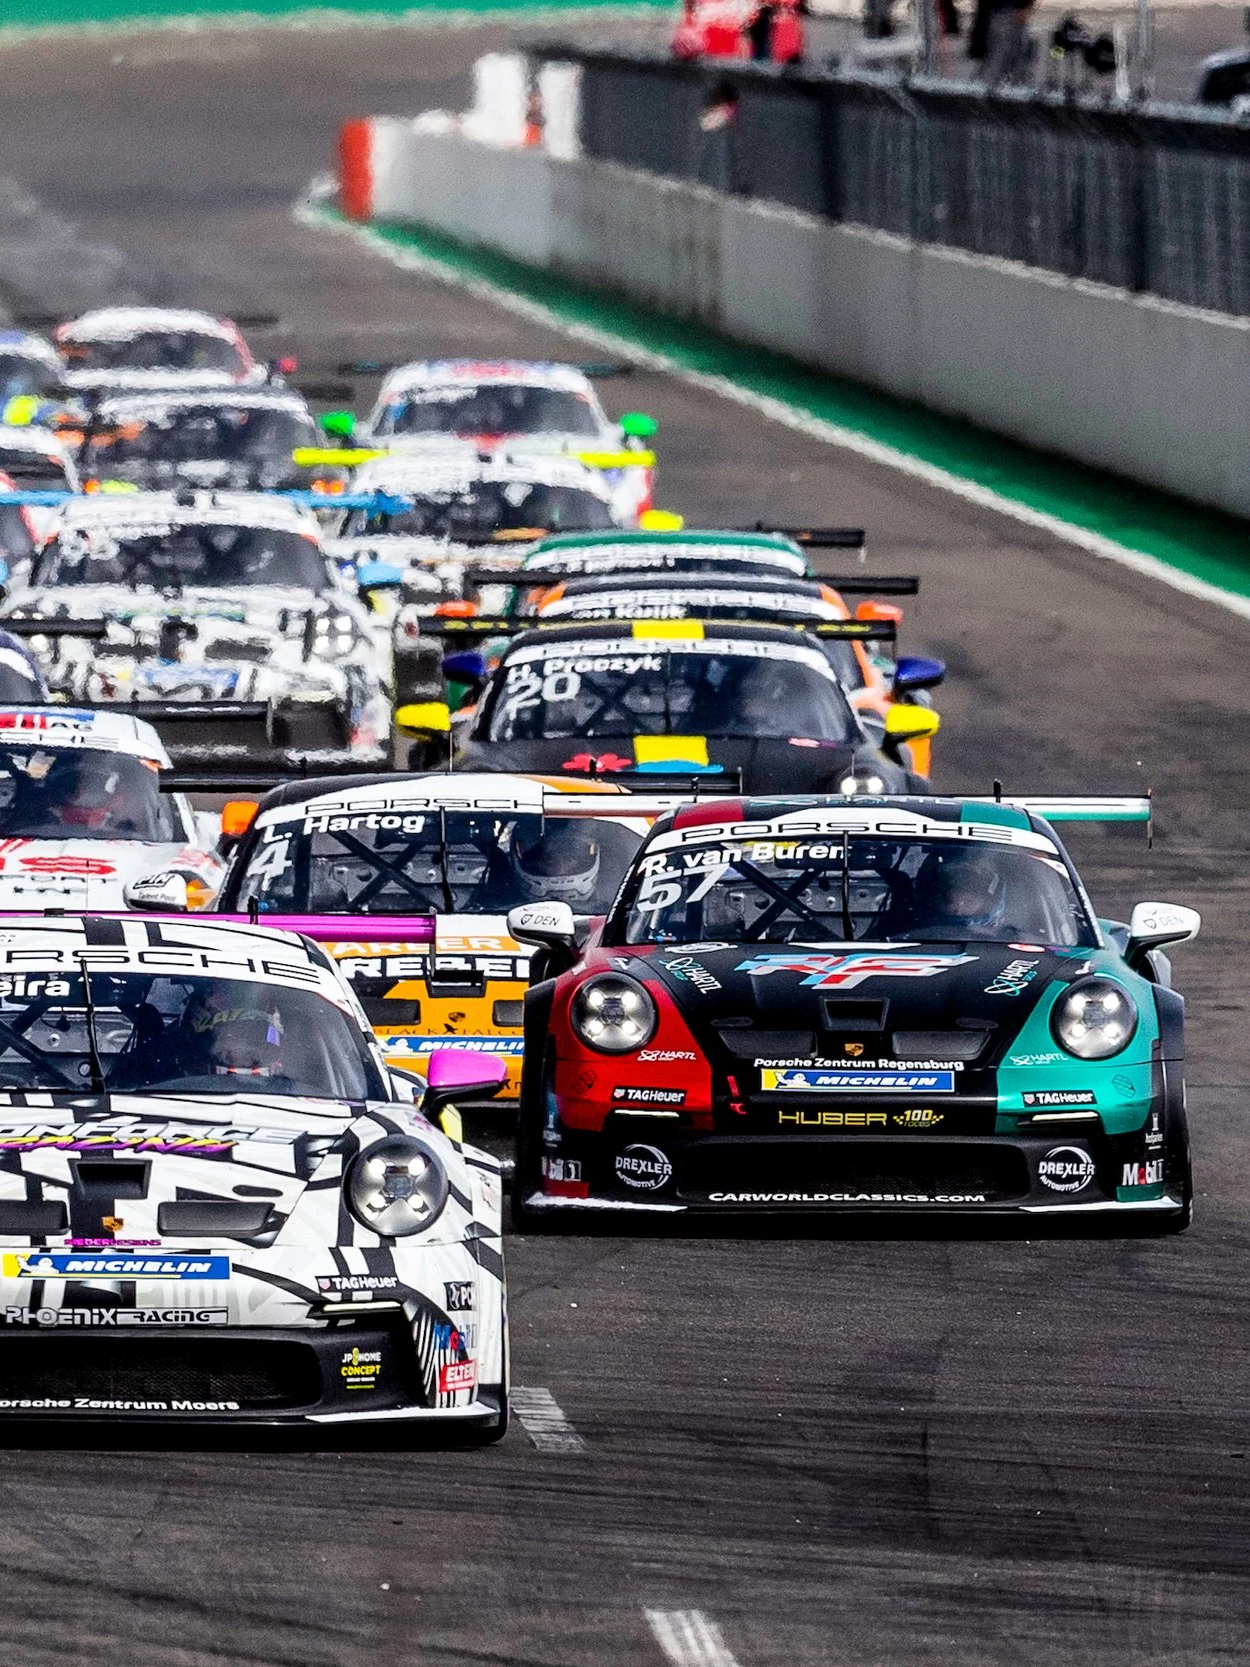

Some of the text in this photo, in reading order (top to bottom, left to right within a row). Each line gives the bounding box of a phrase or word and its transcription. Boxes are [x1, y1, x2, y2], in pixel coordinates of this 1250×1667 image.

[305, 798, 544, 816] PORSCH
[262, 813, 426, 844] L. Hartog
[681, 822, 1014, 843] PORSCHE
[246, 838, 293, 891] 4
[646, 840, 853, 878] R. van Buren
[635, 862, 731, 914] 57
[462, 1026, 525, 1036] FALCO
[754, 1057, 964, 1071] Porsche Zentrum Regensburg
[816, 1076, 937, 1086] MICHELIN
[627, 1089, 684, 1103] TAGHeuer
[1036, 1092, 1094, 1104] TAGHeuer
[778, 1109, 934, 1126] HUBER 100
[615, 1155, 673, 1175] DREXLER
[1038, 1160, 1095, 1179] DREXLER
[615, 1170, 657, 1188] AUTOMOTIVE
[1040, 1174, 1081, 1192] AUTOMOTIVE
[708, 1192, 986, 1203] CARWORLDCLASSICS.COM
[65, 1260, 212, 1273] MICHELIN
[332, 1276, 398, 1289] TAGHeuer
[341, 1364, 382, 1377] CONCEPT
[74, 1398, 168, 1410] Zentrum
[172, 1400, 241, 1411] Moers
